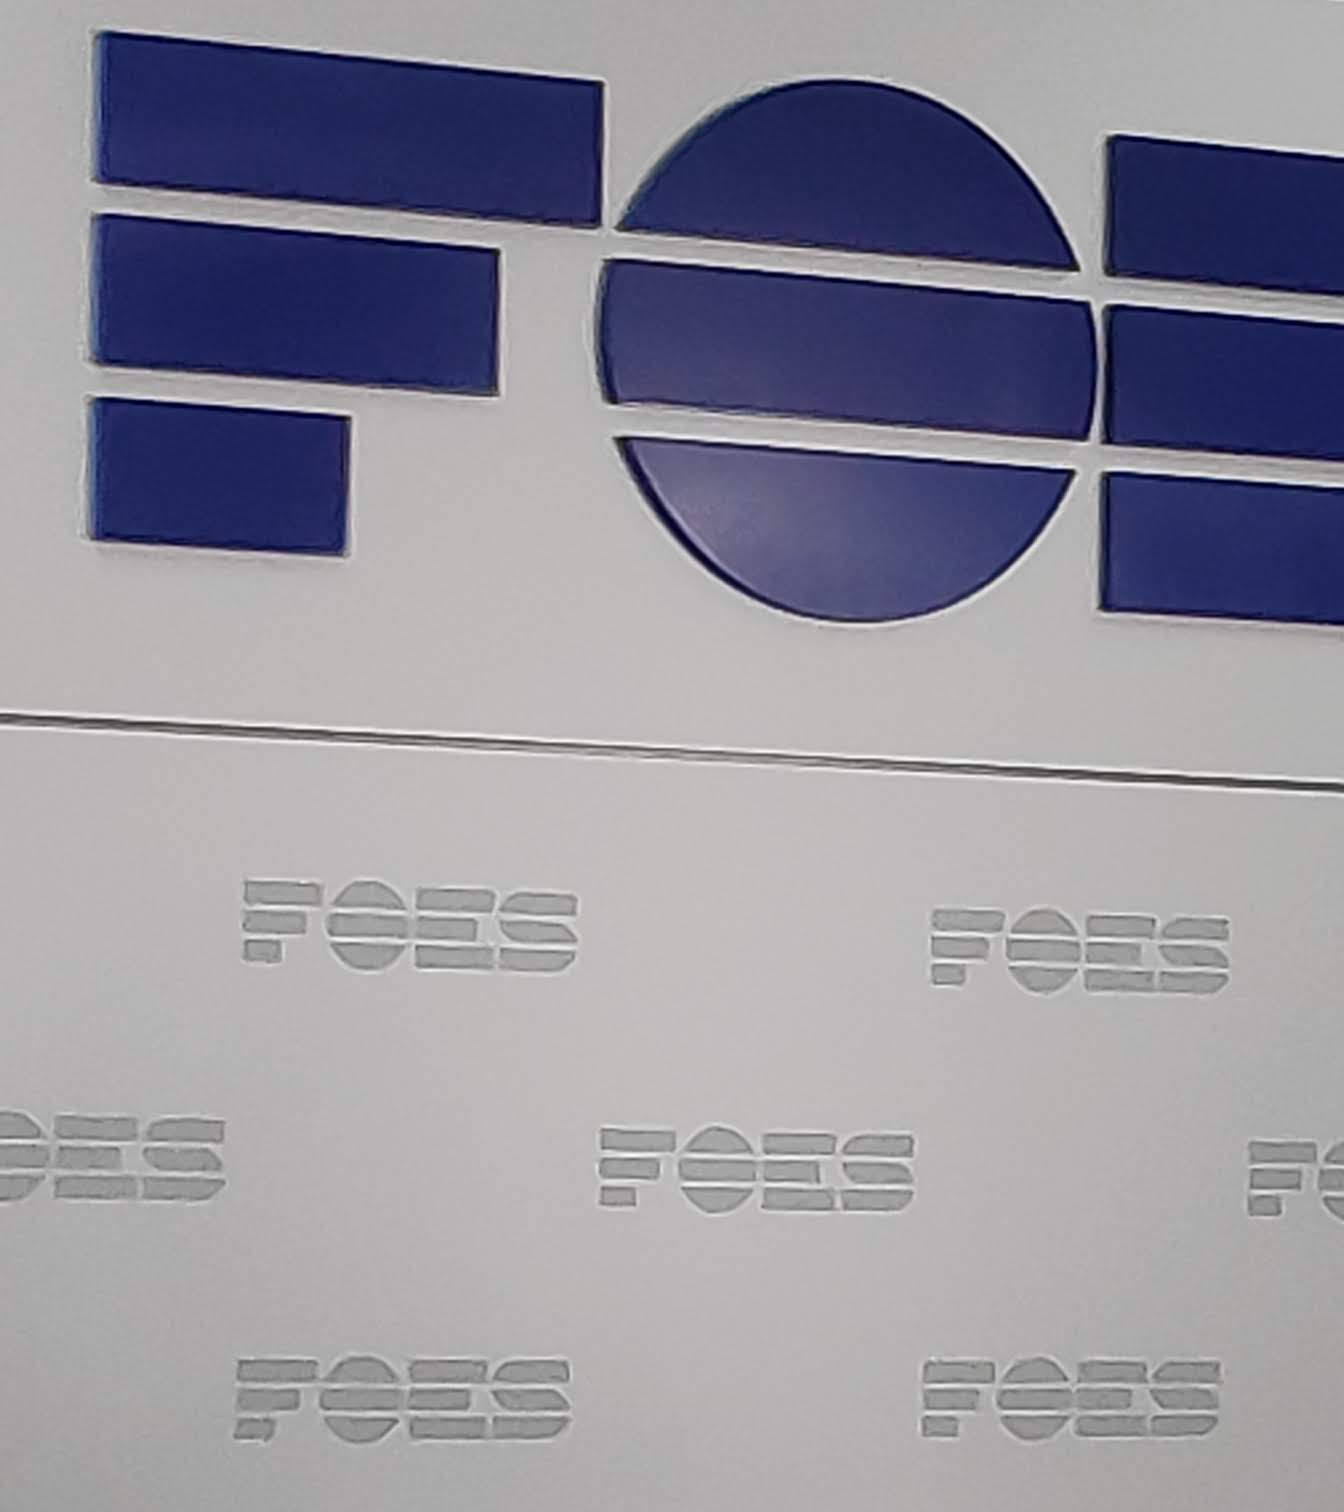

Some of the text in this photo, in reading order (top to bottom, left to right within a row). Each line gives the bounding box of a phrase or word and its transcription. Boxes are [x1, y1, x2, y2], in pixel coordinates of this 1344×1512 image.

[242, 878, 578, 971] FOES
[930, 907, 1229, 994] FOES
[0, 1110, 224, 1202] OES
[599, 1125, 914, 1214] FOES
[234, 1355, 571, 1444] FOES
[921, 1356, 1220, 1441] FOES
